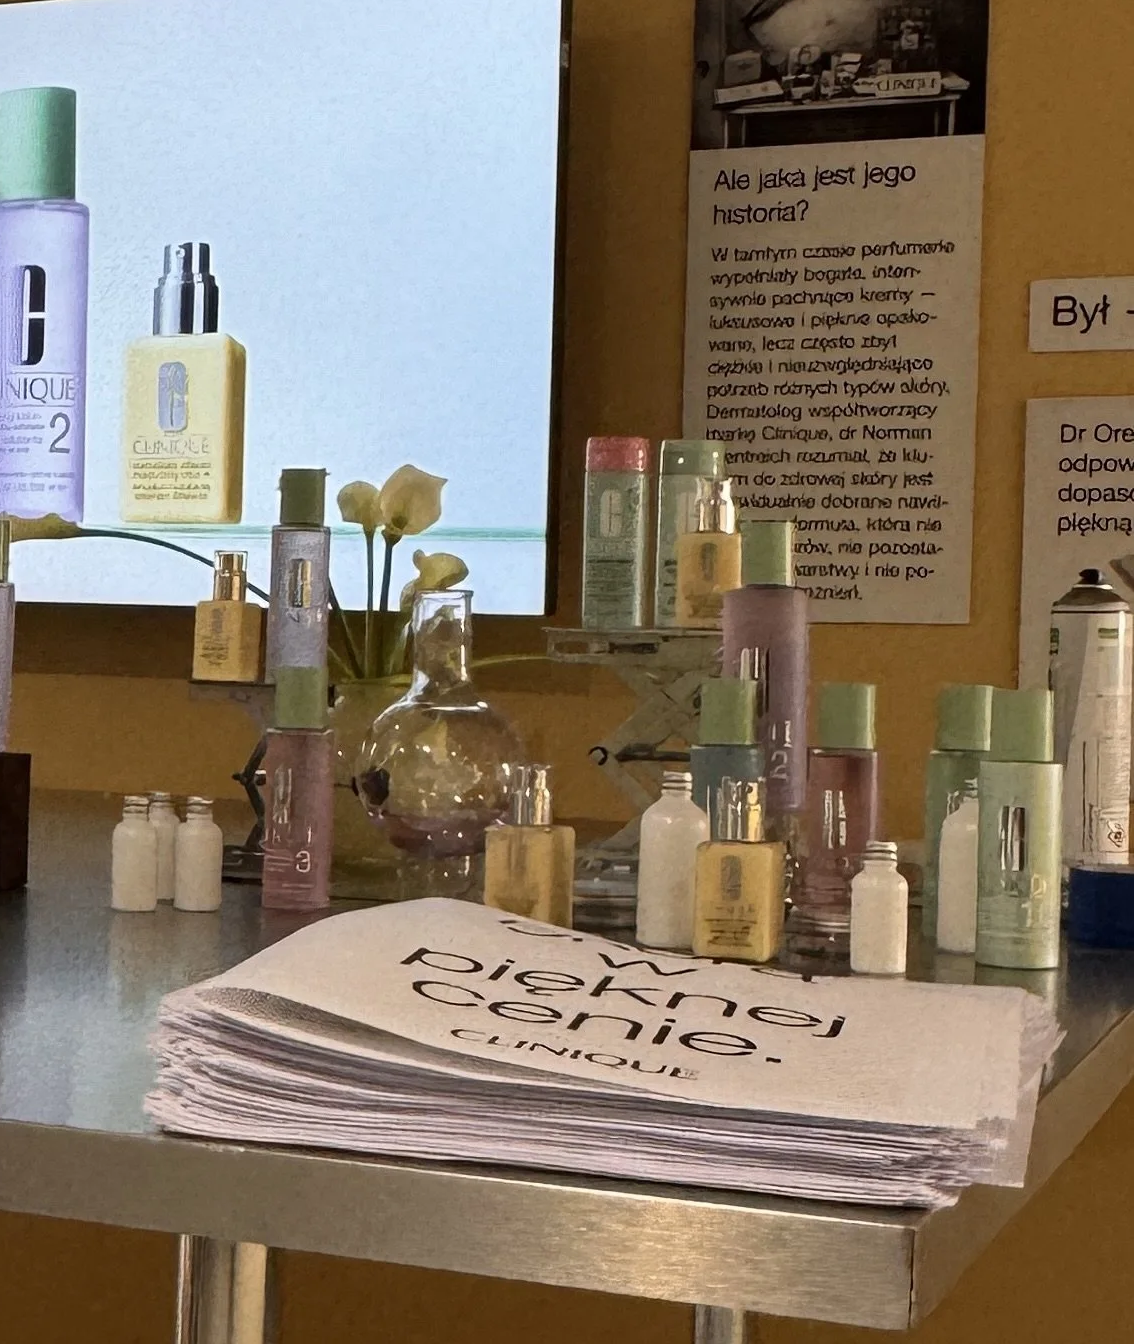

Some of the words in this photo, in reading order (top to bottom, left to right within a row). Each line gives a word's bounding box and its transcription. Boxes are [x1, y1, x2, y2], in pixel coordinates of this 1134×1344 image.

[714, 169, 750, 191] Ale
[757, 168, 806, 193] jaka
[812, 166, 855, 191] jest
[862, 162, 916, 189] jego
[713, 199, 809, 225] historia?
[1052, 294, 1111, 334] Był
[843, 378, 896, 398] typów
[706, 403, 802, 422] Dermatolog
[49, 412, 70, 454] 2
[762, 425, 834, 444] Clinique,
[839, 424, 856, 440] dr
[862, 424, 932, 441] Norman
[1060, 423, 1087, 443] Dr
[724, 448, 791, 465] entreich
[1058, 453, 1134, 477] odpow
[753, 472, 776, 486] do
[780, 471, 846, 489] zdrowej
[1057, 512, 1133, 537] piękną
[400, 946, 847, 1038] pięknej
[412, 980, 782, 1064] cenie.
[450, 1028, 701, 1080] CLINIQUE
